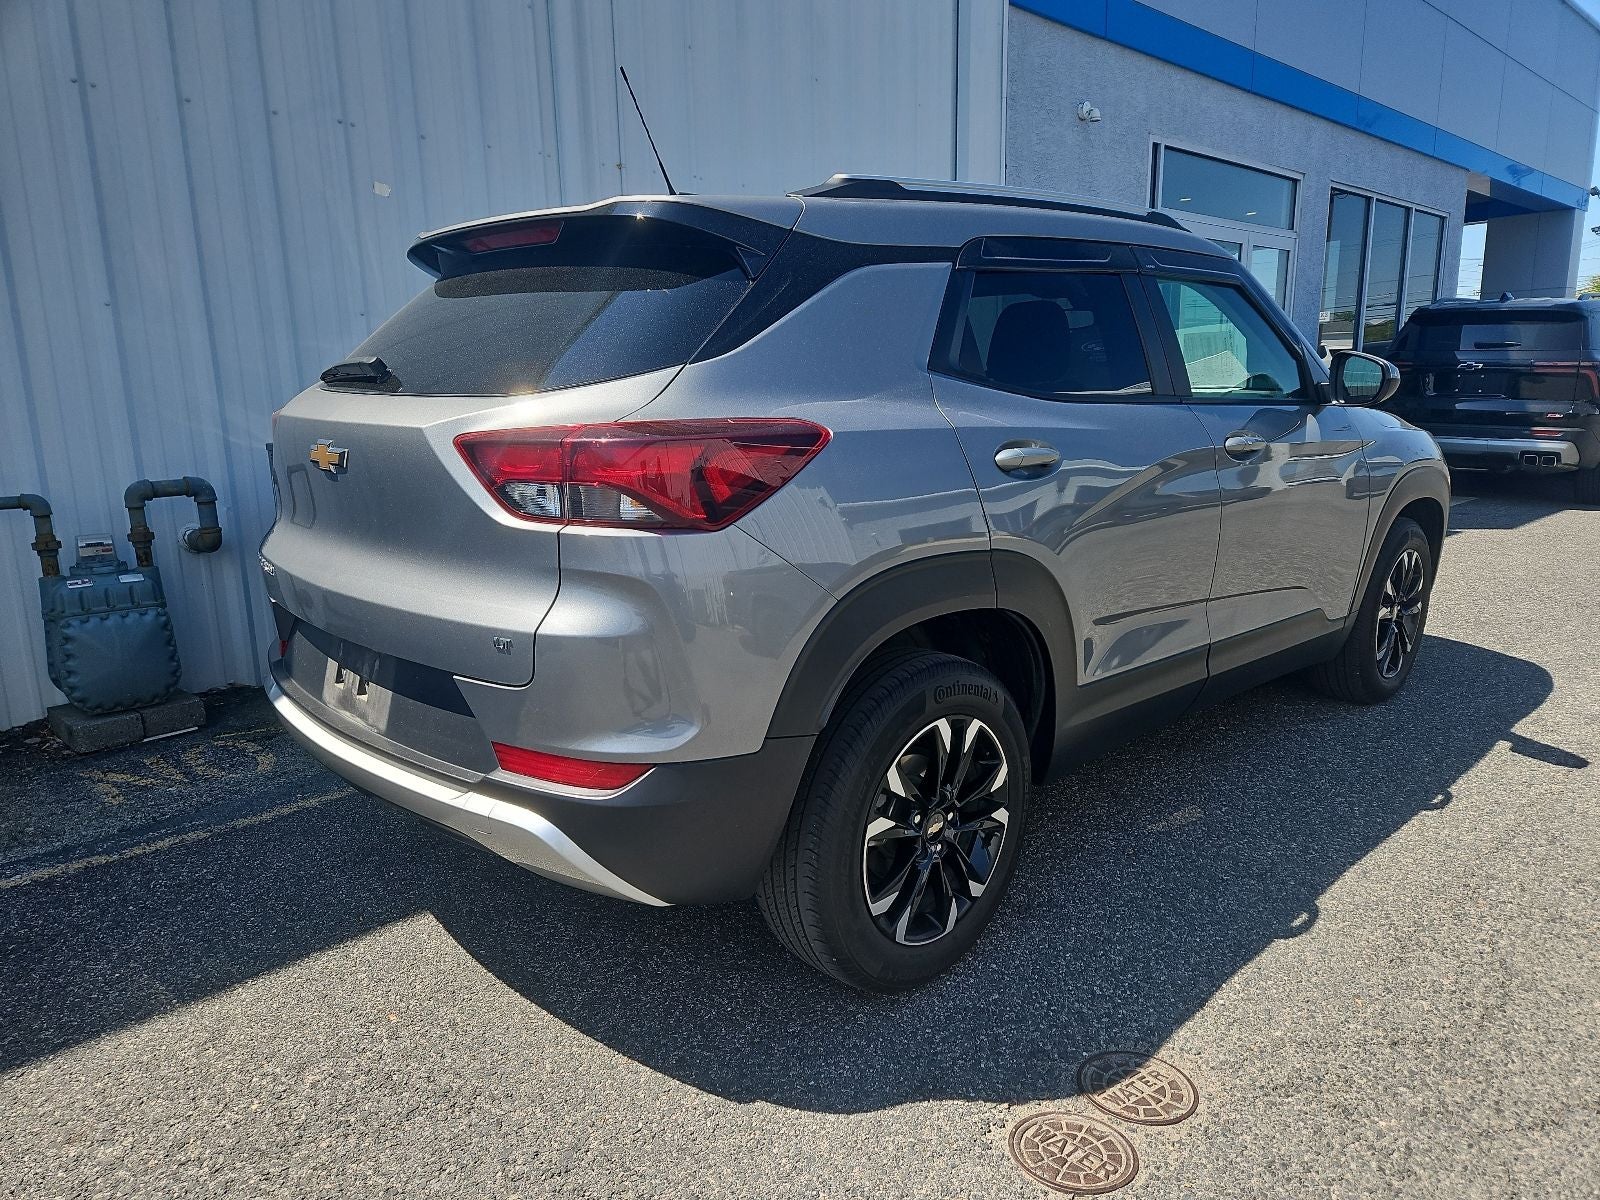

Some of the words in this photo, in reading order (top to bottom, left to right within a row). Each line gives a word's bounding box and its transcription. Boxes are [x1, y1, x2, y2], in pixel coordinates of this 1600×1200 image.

[934, 680, 992, 705] Continental
[1102, 1069, 1172, 1107] WATER
[1030, 1122, 1120, 1182] WATER
